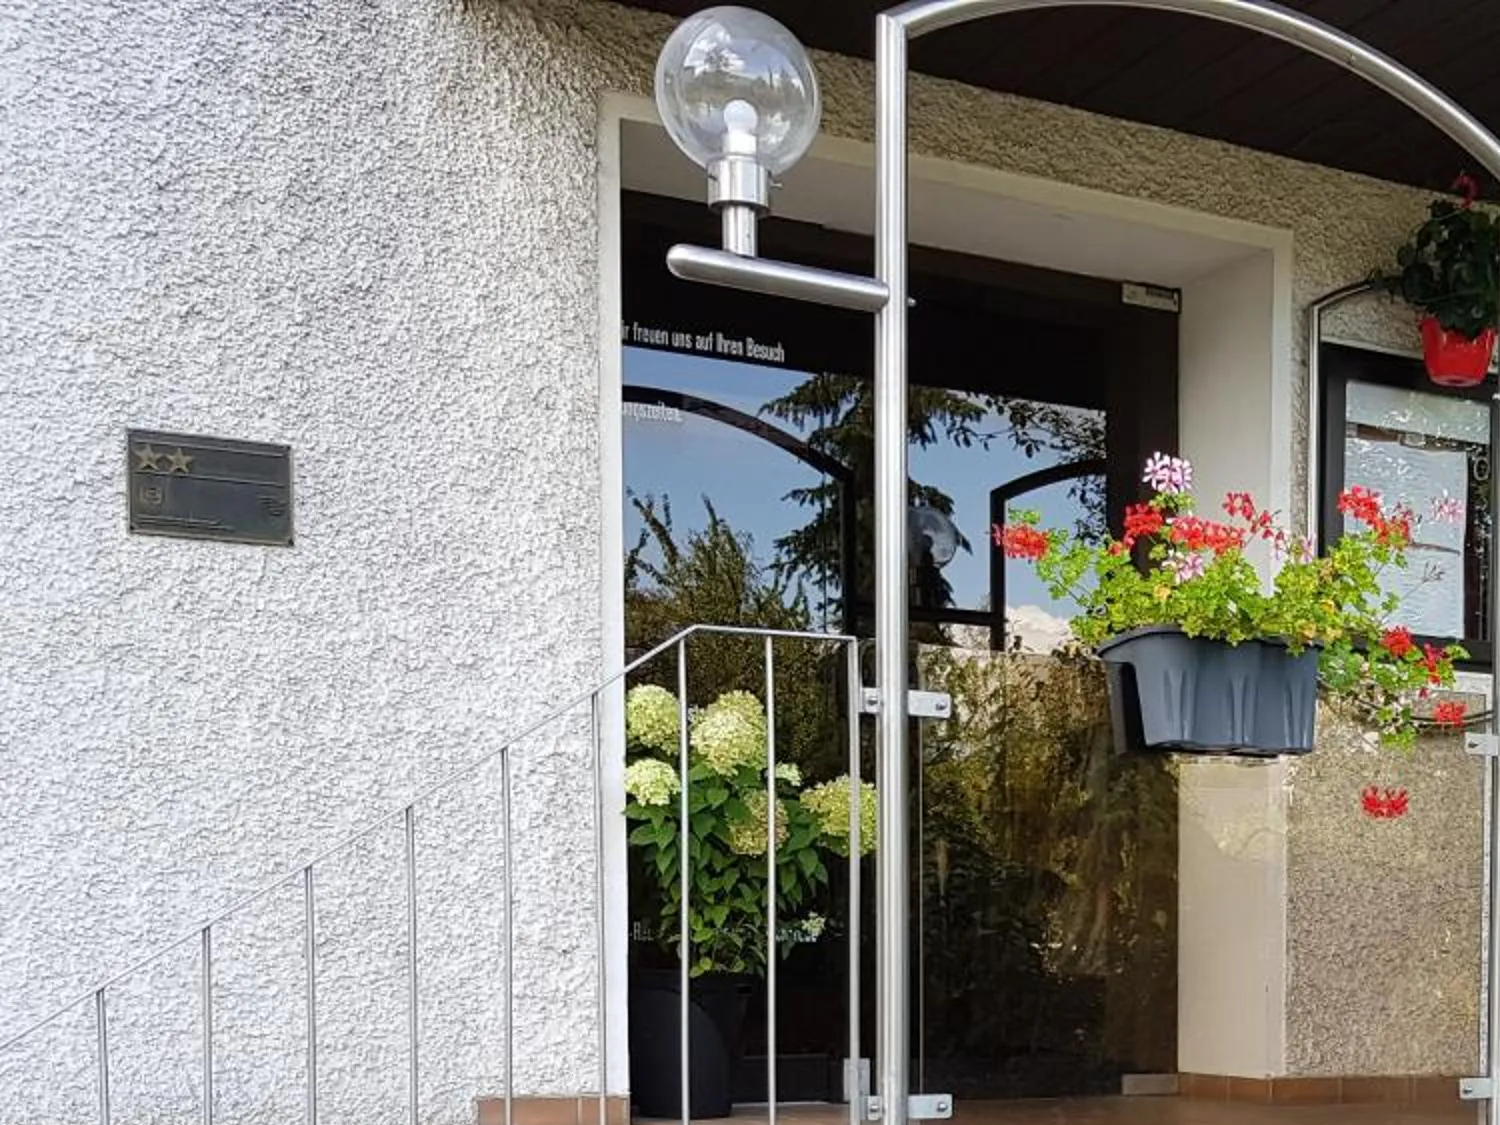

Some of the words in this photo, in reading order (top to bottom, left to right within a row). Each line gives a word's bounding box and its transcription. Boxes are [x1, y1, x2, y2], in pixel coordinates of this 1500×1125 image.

[633, 322, 669, 345] freuen
[671, 331, 692, 349] uns
[695, 332, 713, 351] auf
[716, 332, 743, 356] Ihren
[746, 336, 785, 362] Besuch
